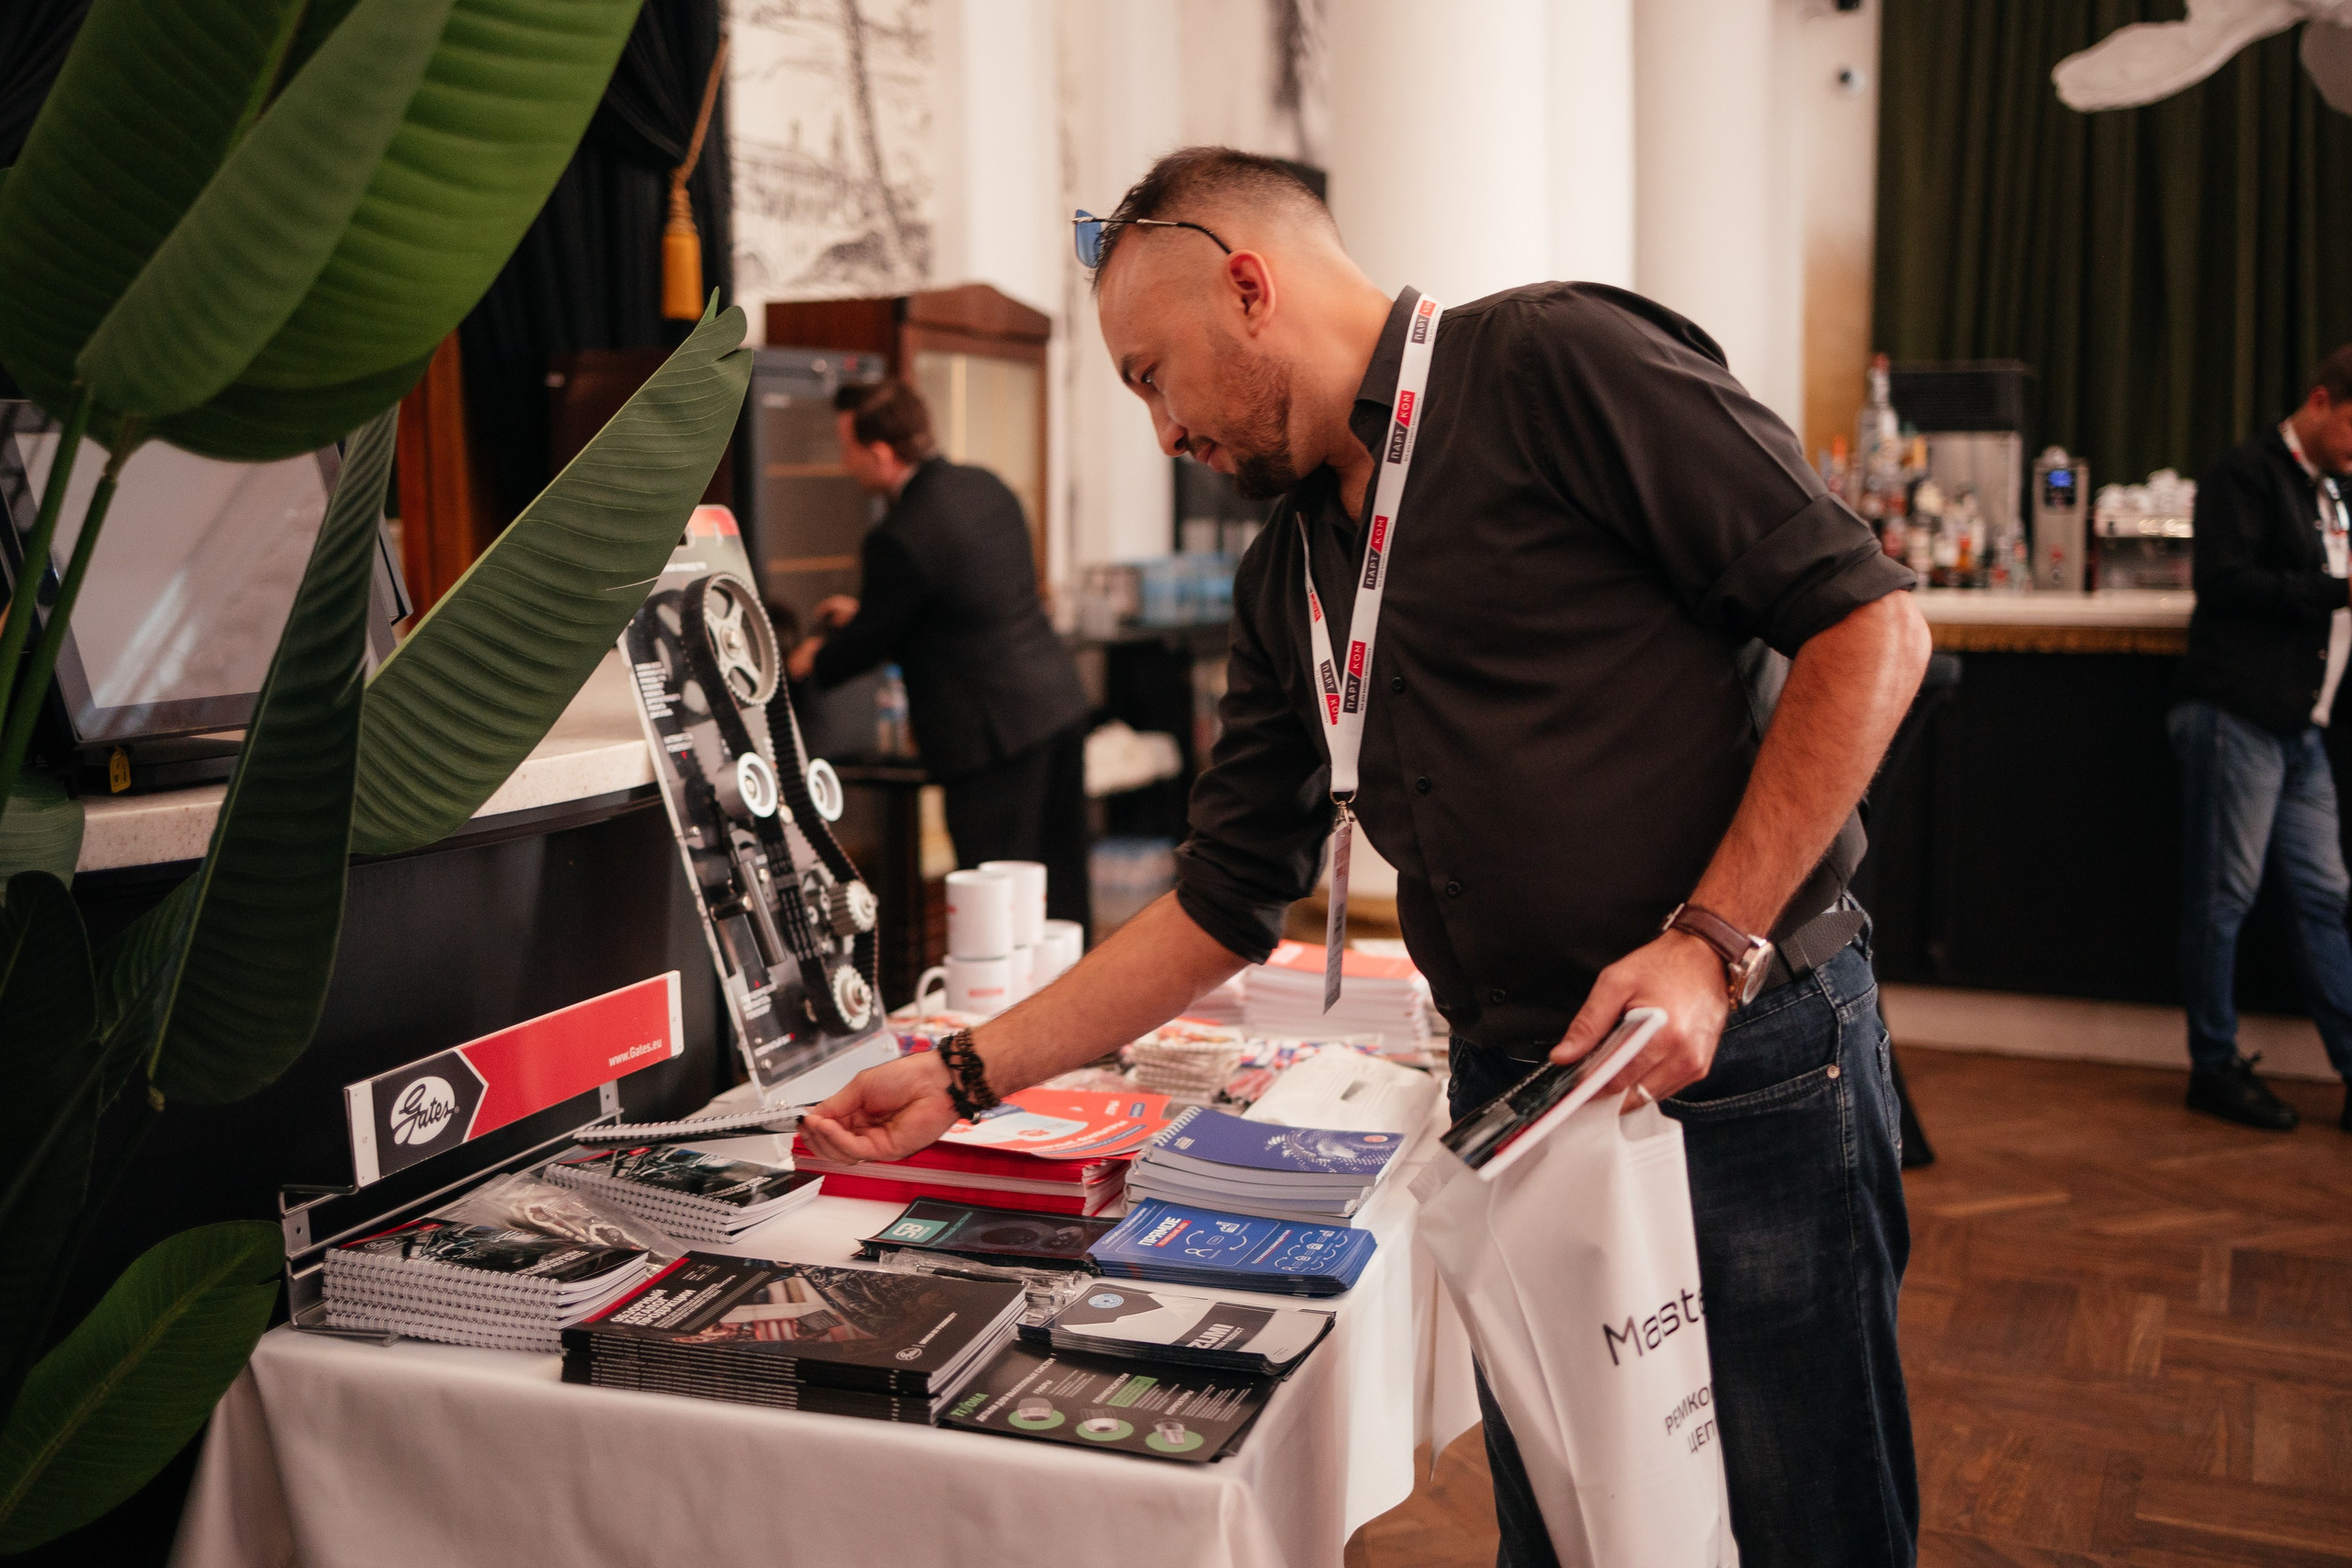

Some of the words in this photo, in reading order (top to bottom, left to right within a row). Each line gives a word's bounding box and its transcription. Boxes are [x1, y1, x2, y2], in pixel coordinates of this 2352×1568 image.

[1390, 429, 1406, 459] ПАРТ
[1399, 394, 1412, 418] КОМ
[1365, 555, 1378, 585] ПАРТ
[1374, 520, 1385, 544] КОМ
[1351, 645, 1363, 669] КОМ
[1322, 664, 1335, 690] ПАРТ
[1347, 680, 1358, 709] ПАРТ
[608, 1038, 662, 1067] www.Gates.eu
[393, 1083, 456, 1144] Gates
[1137, 1216, 1182, 1247] ПРЯМОЕ
[610, 1289, 668, 1323] ОБЗОРНЫЙ
[622, 1297, 671, 1325] КАТАЛОГ
[635, 1290, 697, 1325] ПРОДУКЦИИ
[1185, 1324, 1235, 1349] ZUMI
[1035, 1358, 1057, 1373] СИСТЕМ
